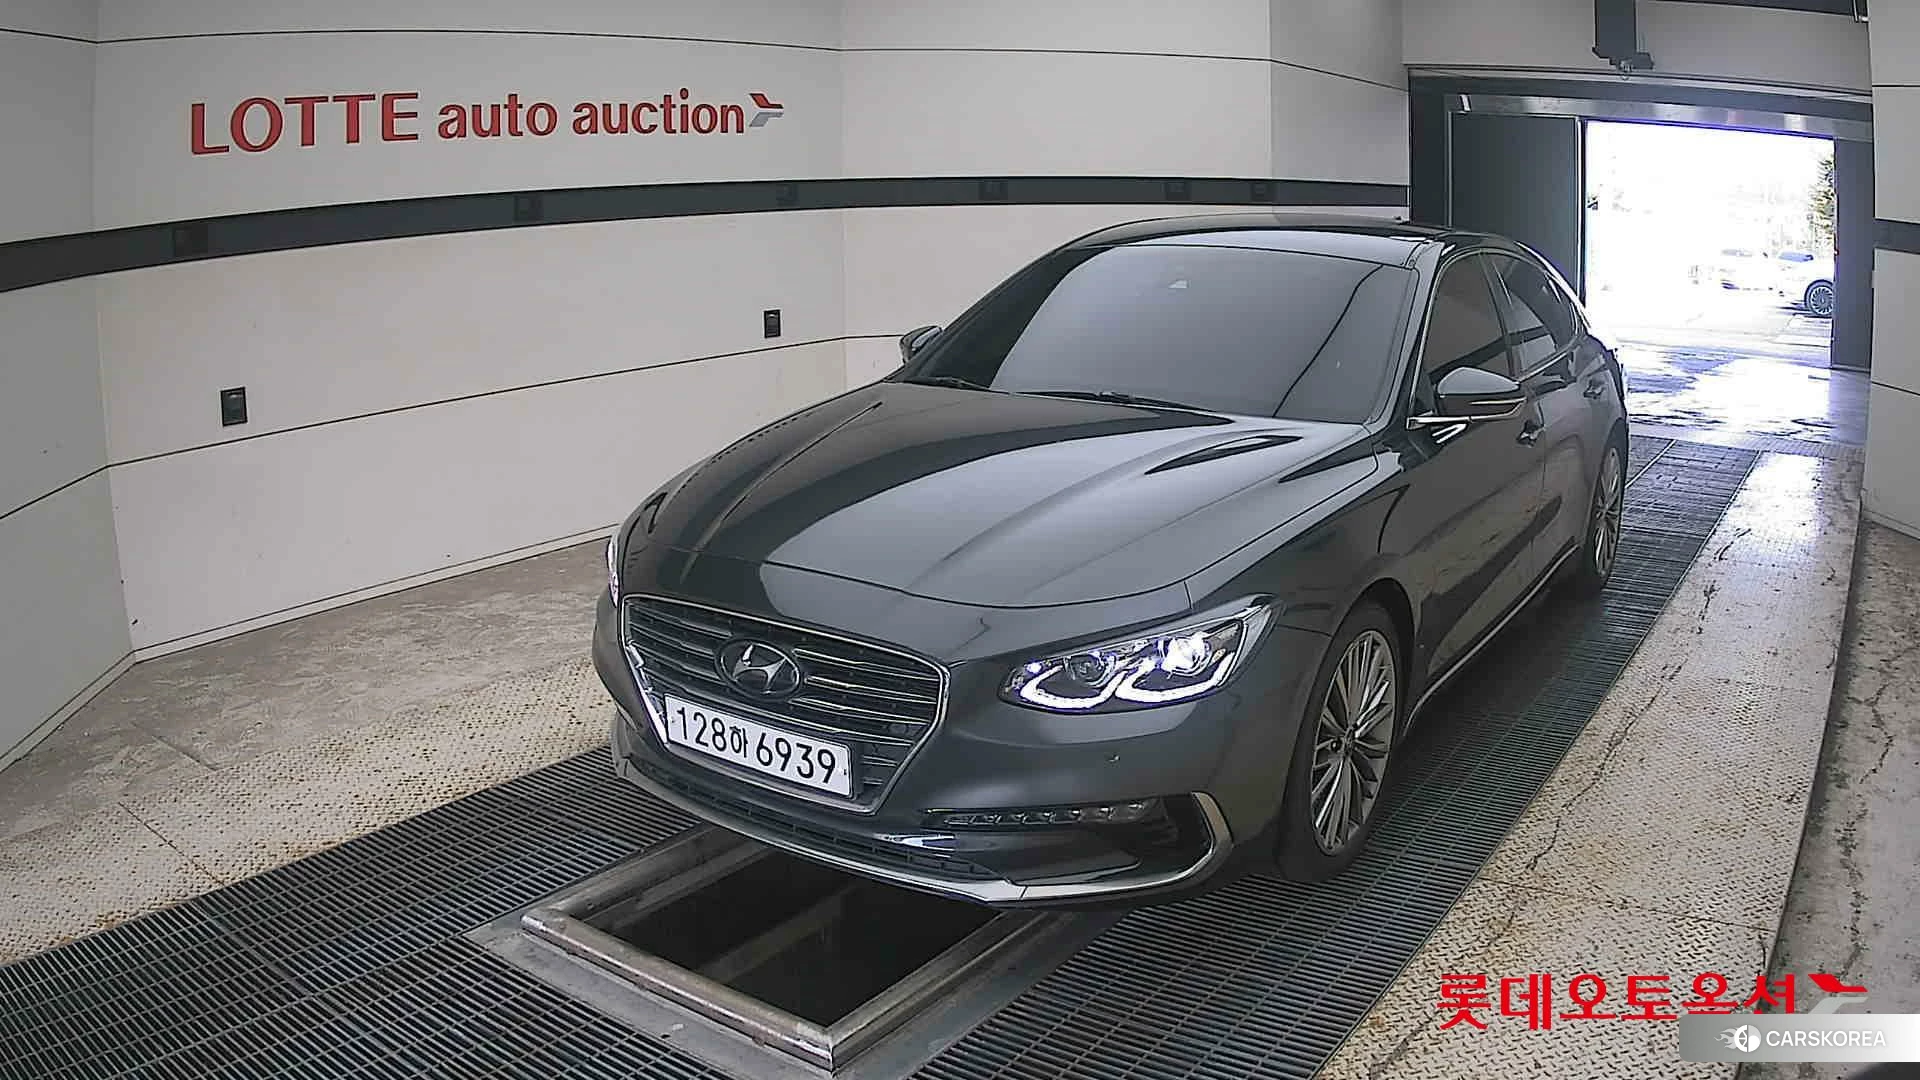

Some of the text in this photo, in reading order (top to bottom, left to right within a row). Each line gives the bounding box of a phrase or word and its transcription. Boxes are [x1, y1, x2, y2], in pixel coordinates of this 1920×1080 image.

[191, 87, 745, 155] LOTTE auto auction
